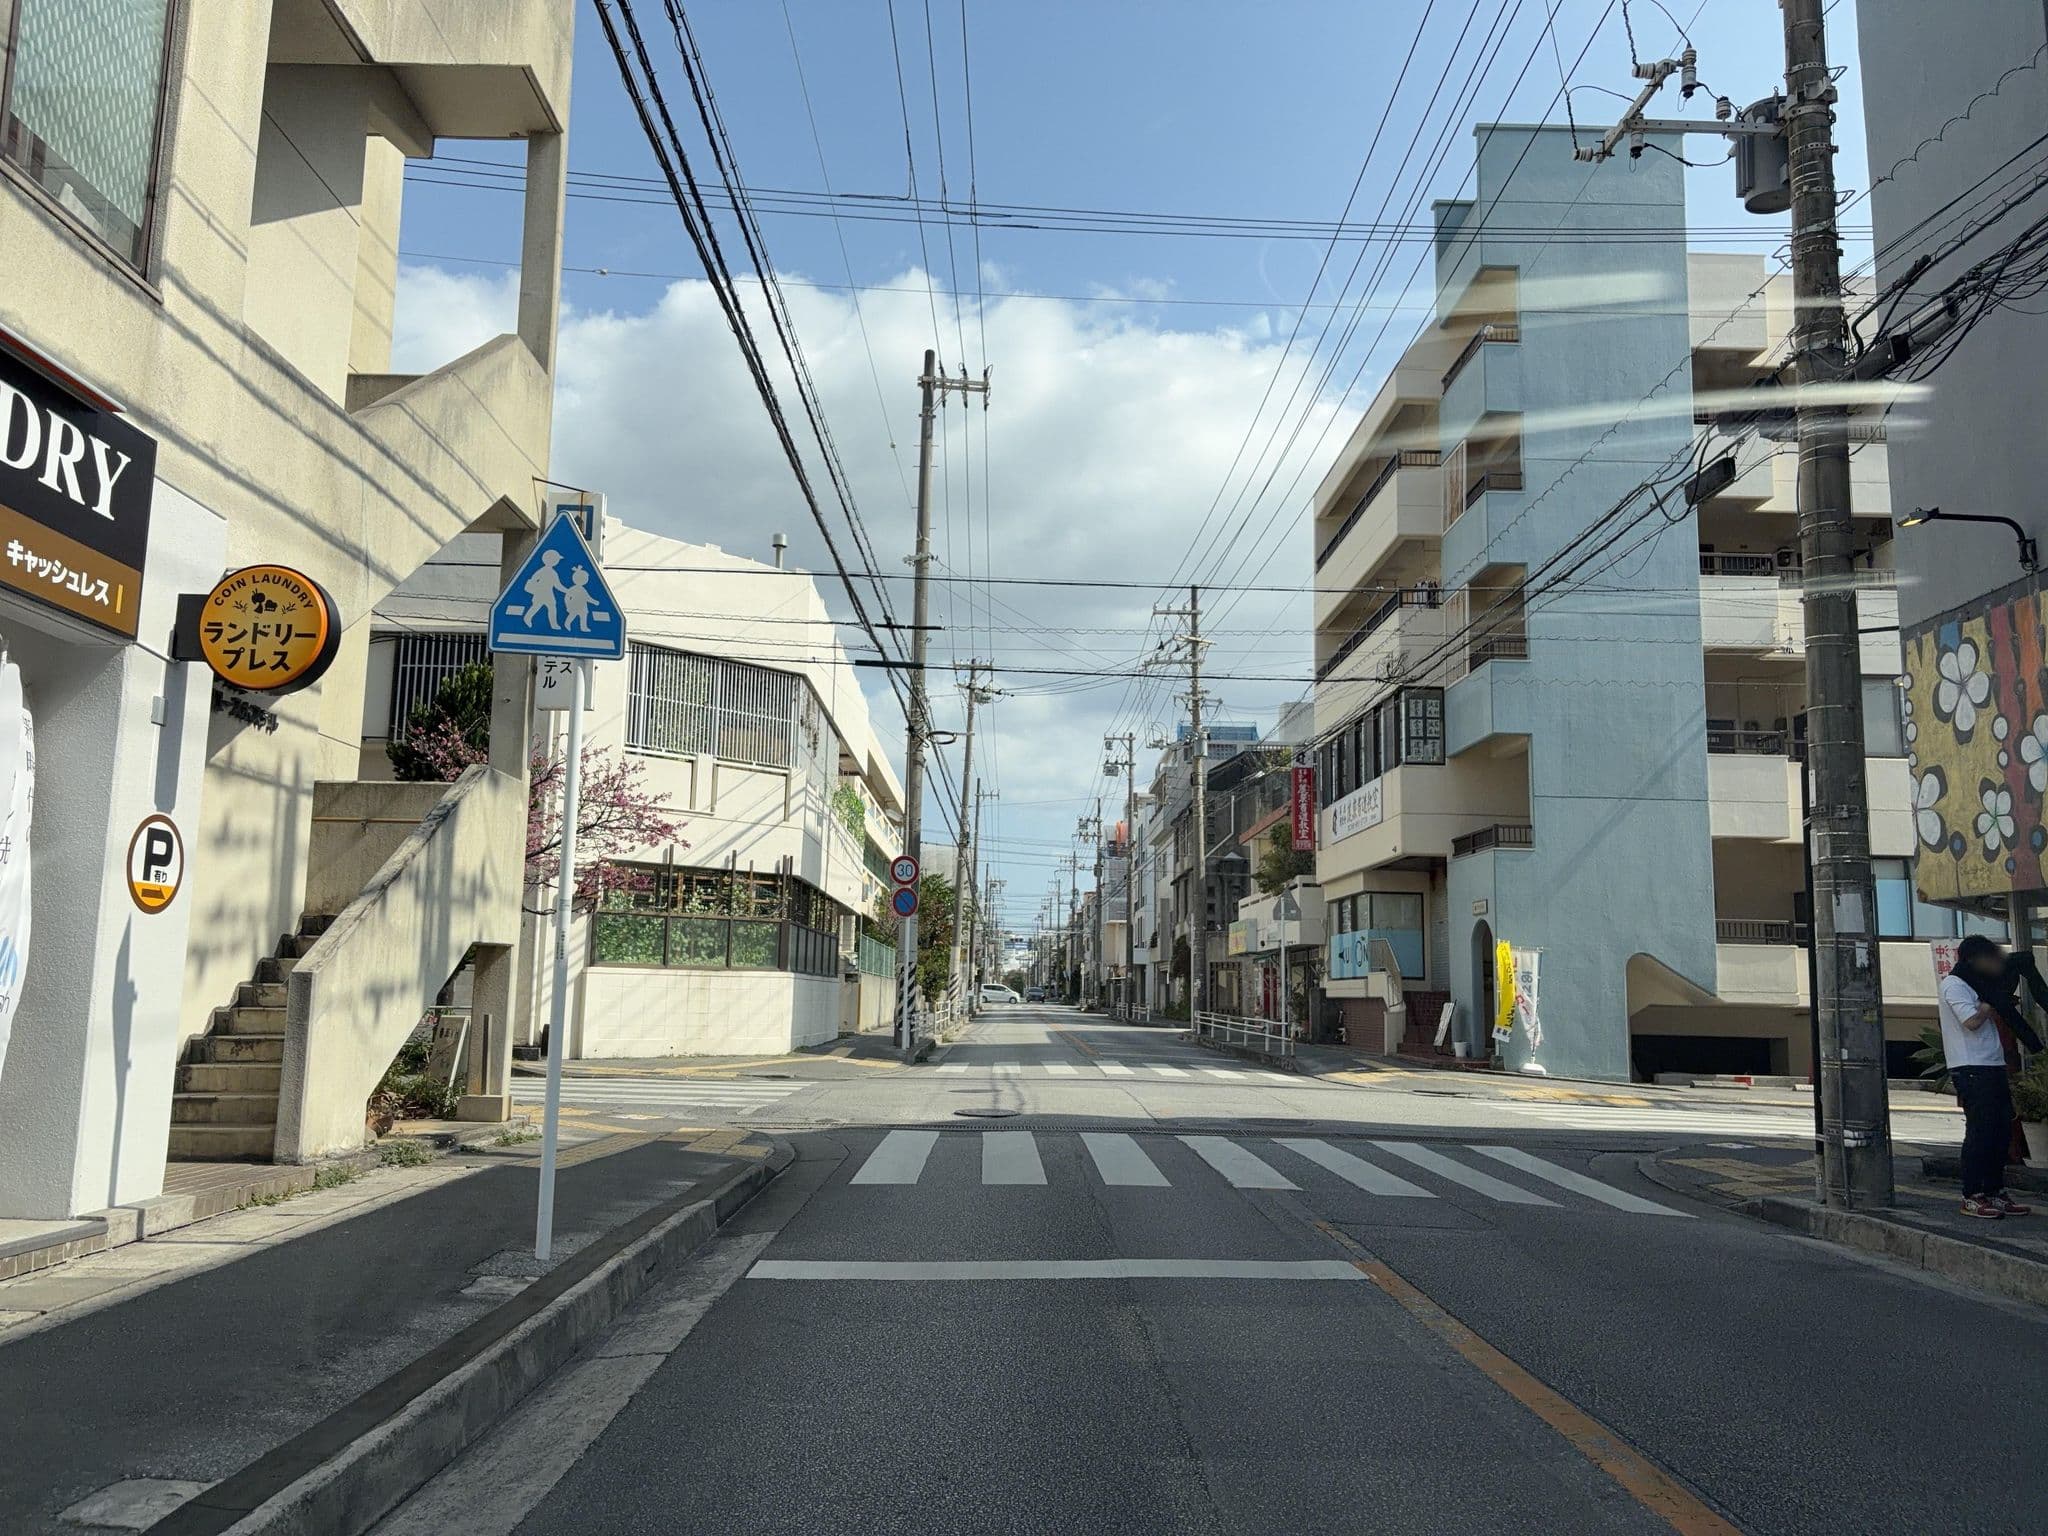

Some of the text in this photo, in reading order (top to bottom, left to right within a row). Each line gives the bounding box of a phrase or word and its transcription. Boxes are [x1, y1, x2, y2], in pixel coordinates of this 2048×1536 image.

[0, 379, 132, 520] DRY
[6, 539, 110, 606] キャッシュレス
[214, 574, 314, 609] COIN LAUNDRY
[204, 621, 317, 646] ランドリー
[222, 647, 291, 671] プレス
[542, 656, 558, 690] テル
[142, 827, 173, 882] P
[896, 863, 913, 878] 30
[153, 869, 168, 884] 有り
